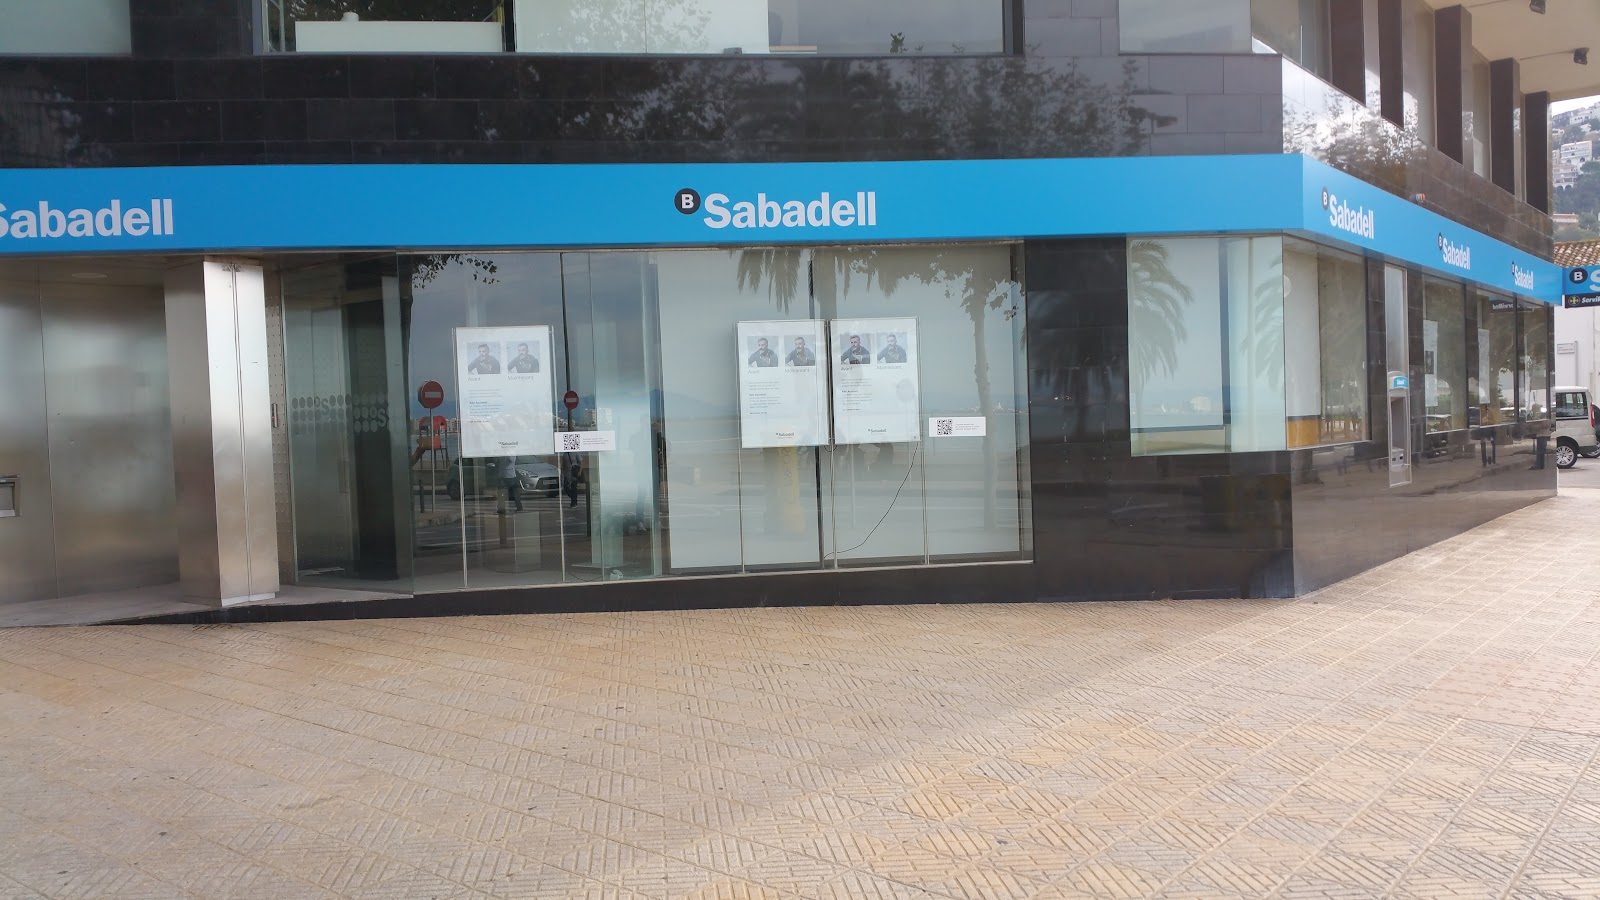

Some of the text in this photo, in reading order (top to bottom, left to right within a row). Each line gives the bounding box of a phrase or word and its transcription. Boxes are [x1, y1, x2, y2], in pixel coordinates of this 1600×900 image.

[0, 198, 174, 239] abadell
[703, 191, 877, 229] Sabadell
[1329, 193, 1374, 239] Sabadell
[1442, 237, 1471, 270] Sabadell
